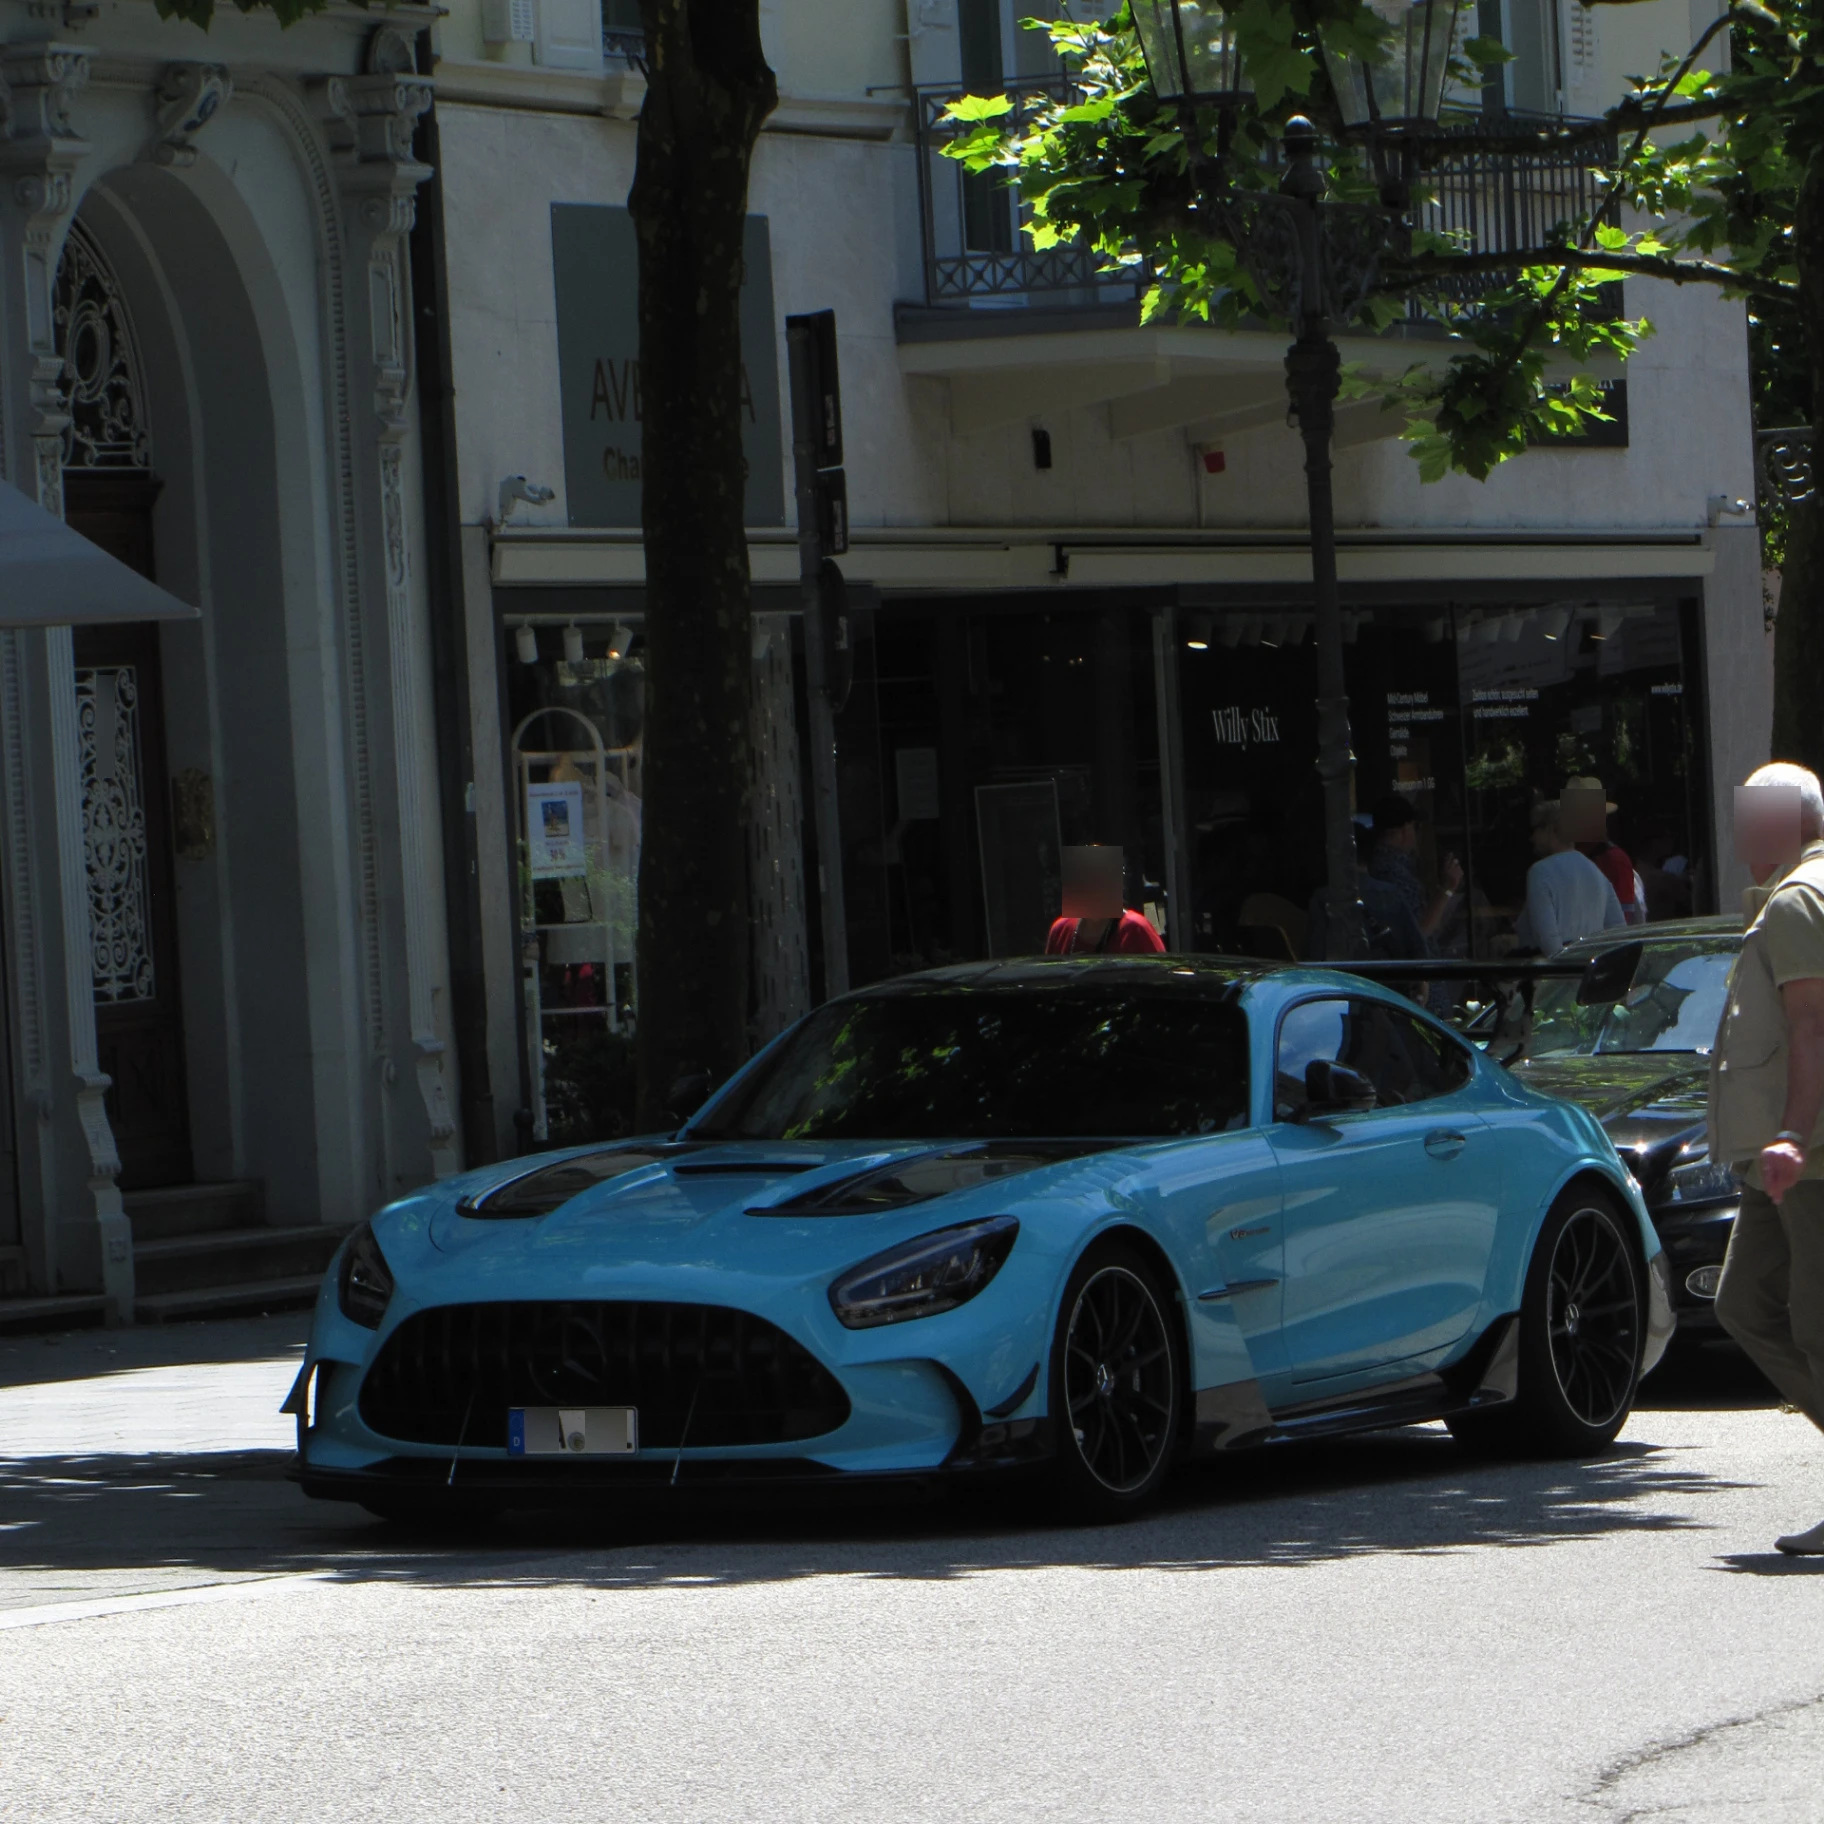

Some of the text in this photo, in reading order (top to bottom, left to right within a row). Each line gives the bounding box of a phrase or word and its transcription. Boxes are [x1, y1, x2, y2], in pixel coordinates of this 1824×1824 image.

[1211, 706, 1281, 752] Willy Stix
[513, 1435, 521, 1447] D
